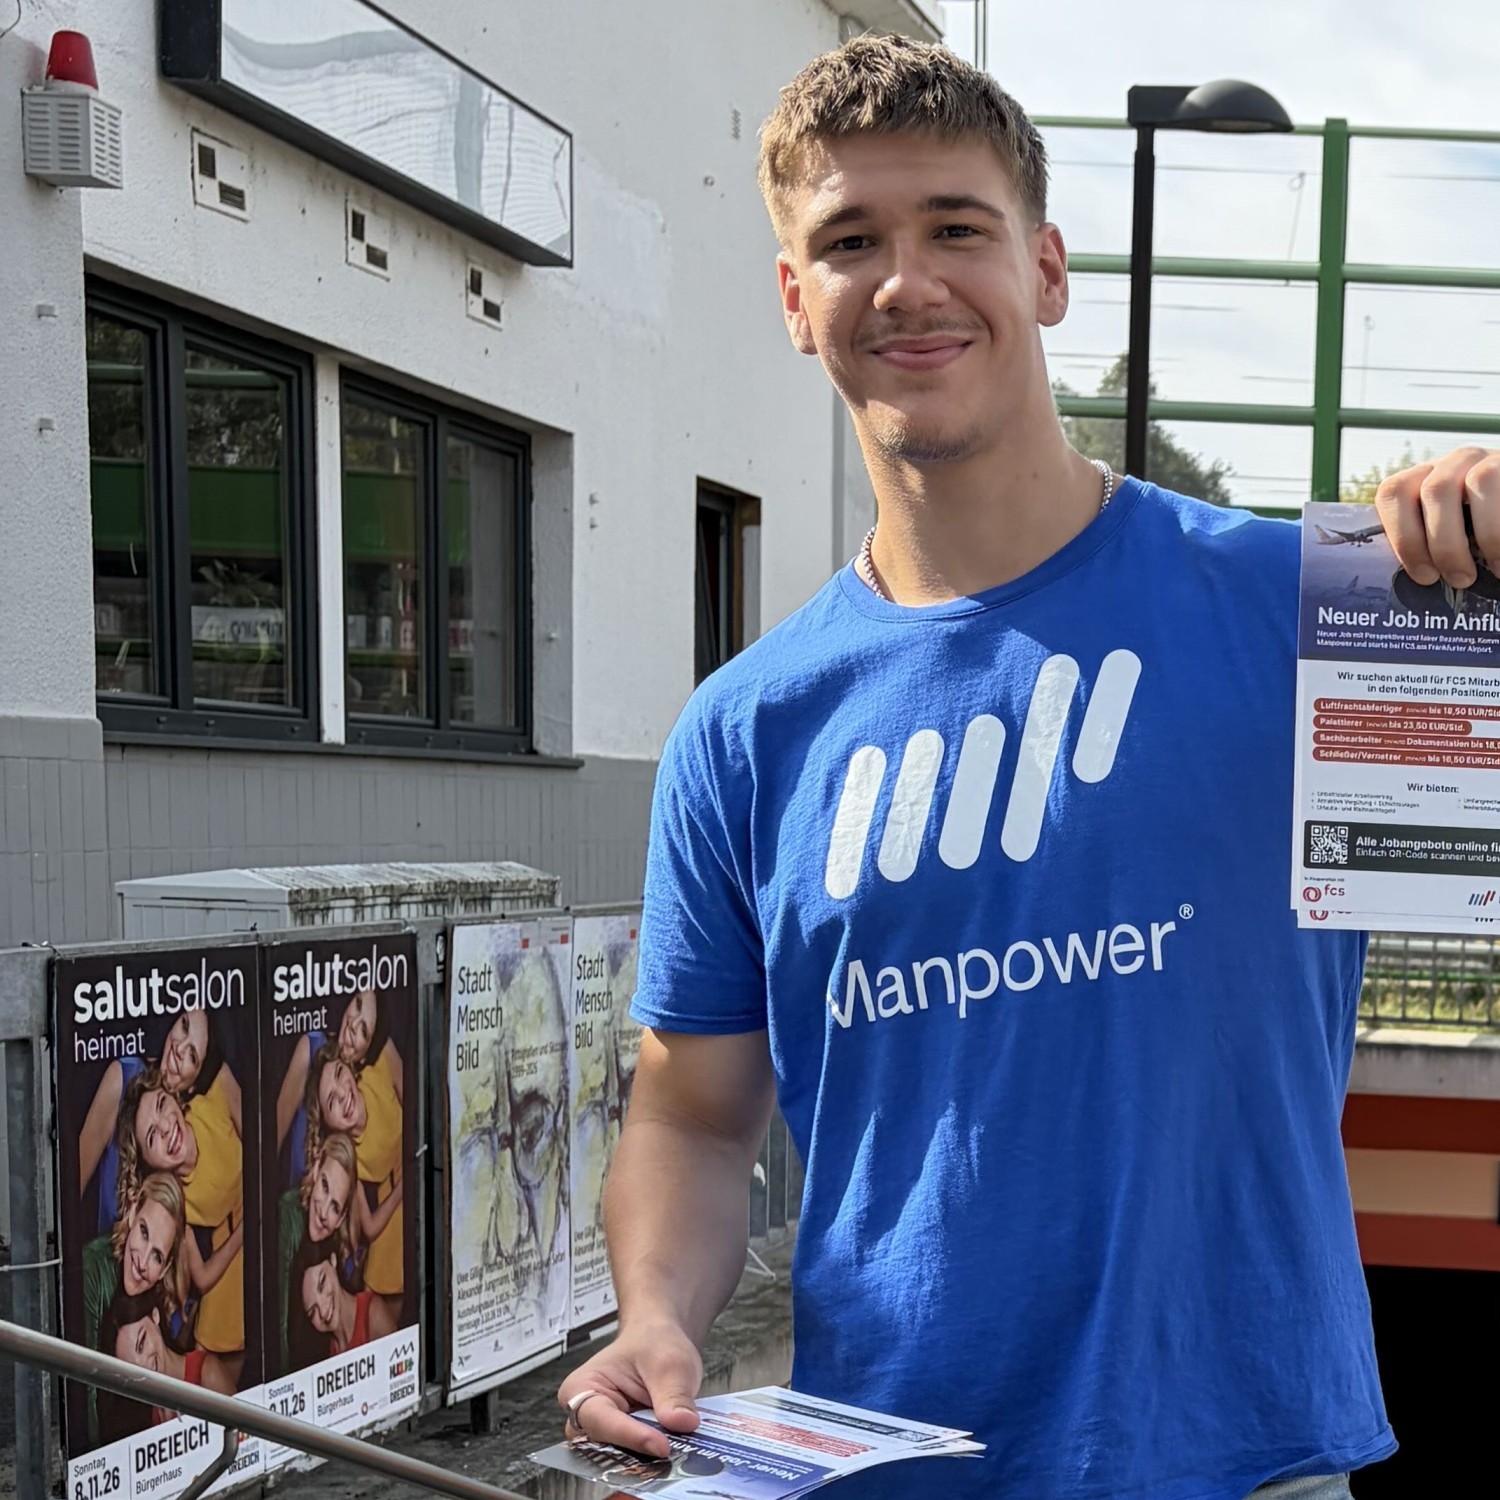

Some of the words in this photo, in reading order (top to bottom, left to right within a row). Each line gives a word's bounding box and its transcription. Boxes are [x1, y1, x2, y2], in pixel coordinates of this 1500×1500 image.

[1317, 607, 1379, 627] Neuer
[1383, 610, 1420, 629] Job
[1425, 611, 1448, 630] im
[1353, 640, 1366, 648] und
[1389, 641, 1400, 649] bei
[1365, 632, 1405, 641] Perspektive
[1337, 671, 1354, 681] Wir
[1357, 673, 1392, 683] suchen
[1395, 674, 1428, 684] aktuell
[1430, 675, 1444, 685] für
[1446, 676, 1466, 686] FCS
[1367, 683, 1376, 692] in
[1379, 684, 1397, 694] den
[1399, 685, 1449, 698] folgenden
[1320, 701, 1402, 714] Luftfrachtabfertiger
[1429, 706, 1441, 714] bis
[1389, 721, 1401, 729] bis
[1403, 721, 1427, 731] 23,50
[1429, 722, 1465, 732] EUR/Std.
[1319, 733, 1382, 744] Sachbearbeiter
[1407, 737, 1469, 748] Dokumentation
[1470, 740, 1483, 749] bis
[1428, 754, 1440, 762] bis
[1407, 782, 1424, 792] Wir
[1426, 783, 1459, 794] bieten:
[1355, 847, 1387, 857] Einfach
[1389, 849, 1428, 859] QR-Code
[1430, 852, 1466, 861] scannen
[1467, 853, 1484, 862] und
[1356, 836, 1378, 847] Alle
[1380, 837, 1452, 851] Jobangebote
[1455, 840, 1488, 852] online
[1324, 884, 1345, 896] fcs
[273, 944, 408, 1003] salutsalon
[576, 952, 605, 981] Stadt
[457, 963, 493, 996] Stadt
[73, 957, 245, 1024] salutsalon
[575, 987, 613, 1016] Mensch
[273, 1006, 328, 1037] heimat
[456, 998, 503, 1034] Mensch
[74, 1027, 145, 1062] heimat
[575, 1020, 593, 1050] Bild
[456, 1040, 480, 1072] Bild
[317, 1354, 376, 1399] DREIEICH
[268, 1381, 295, 1400] Sonntag
[389, 1383, 415, 1404] DREIEICH
[317, 1393, 354, 1417] Bürgerhaus
[135, 1420, 209, 1473] DREIEICH
[697, 1448, 720, 1460] im
[74, 1456, 106, 1478] Sonntag
[719, 1455, 751, 1467] Job
[136, 1466, 183, 1495] Bürgerhaus
[748, 1463, 801, 1481] Neuer
